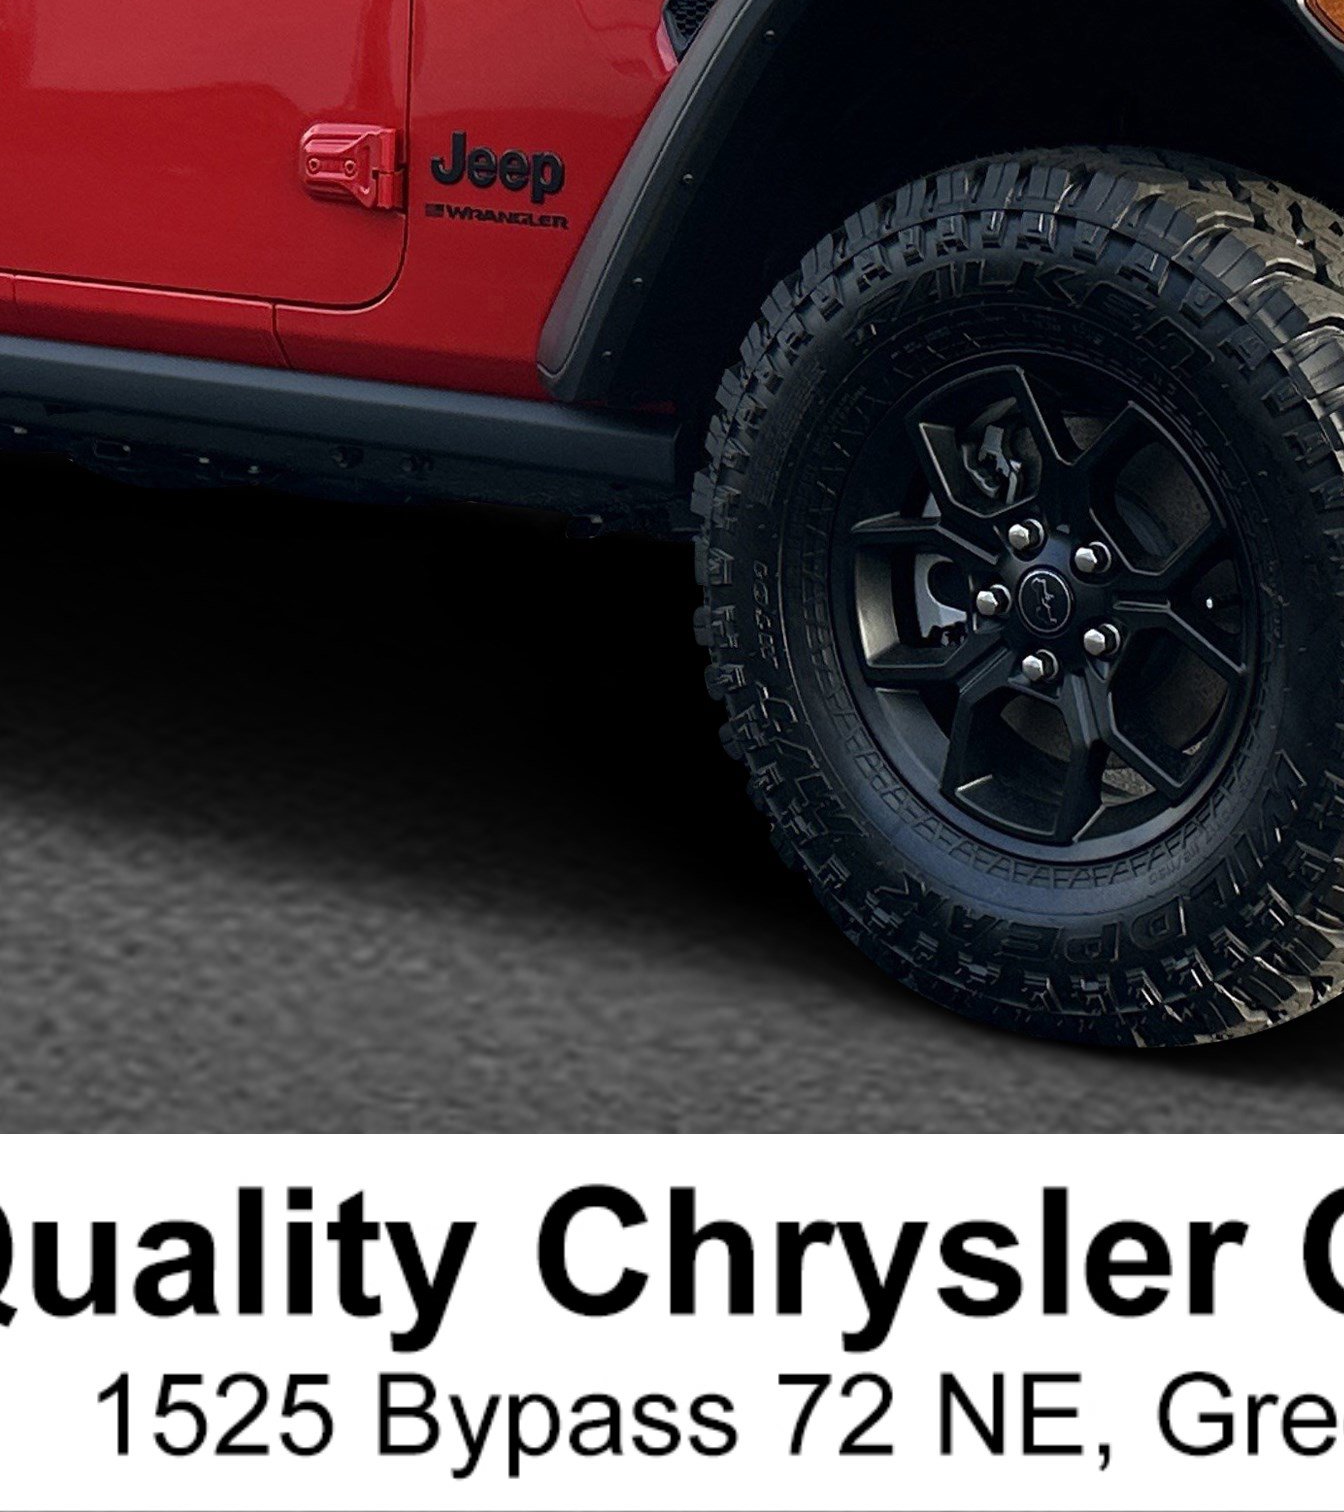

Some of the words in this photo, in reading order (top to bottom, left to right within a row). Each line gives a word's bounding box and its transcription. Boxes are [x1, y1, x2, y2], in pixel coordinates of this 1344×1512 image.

[430, 131, 566, 205] Jeep
[446, 204, 569, 230] WRANGLER
[844, 255, 1218, 370] FALKEN
